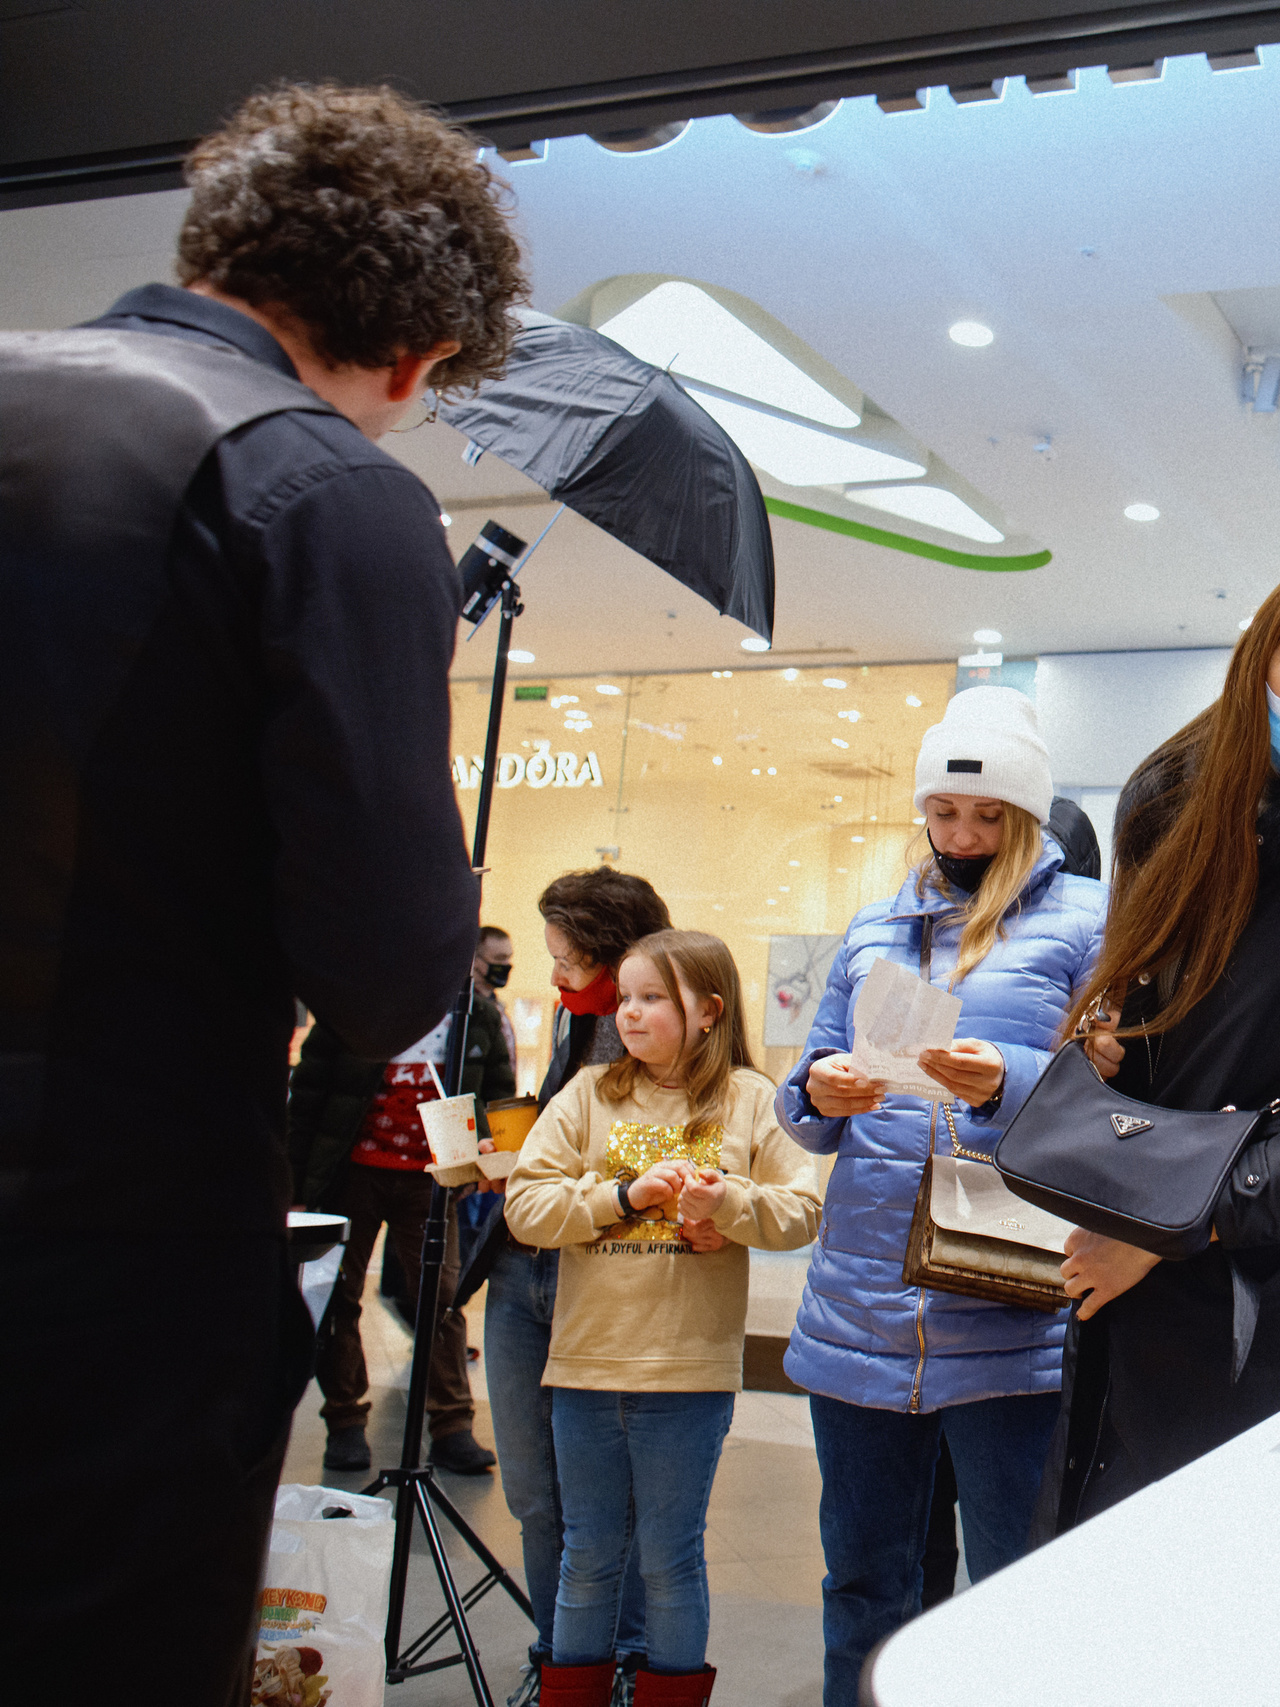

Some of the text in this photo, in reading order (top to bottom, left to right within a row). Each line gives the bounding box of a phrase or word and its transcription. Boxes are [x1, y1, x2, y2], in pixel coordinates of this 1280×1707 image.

[451, 740, 604, 789] ANDORA
[602, 1242, 608, 1254] A
[609, 1242, 643, 1256] JOYFUL
[285, 1588, 327, 1614] KONG
